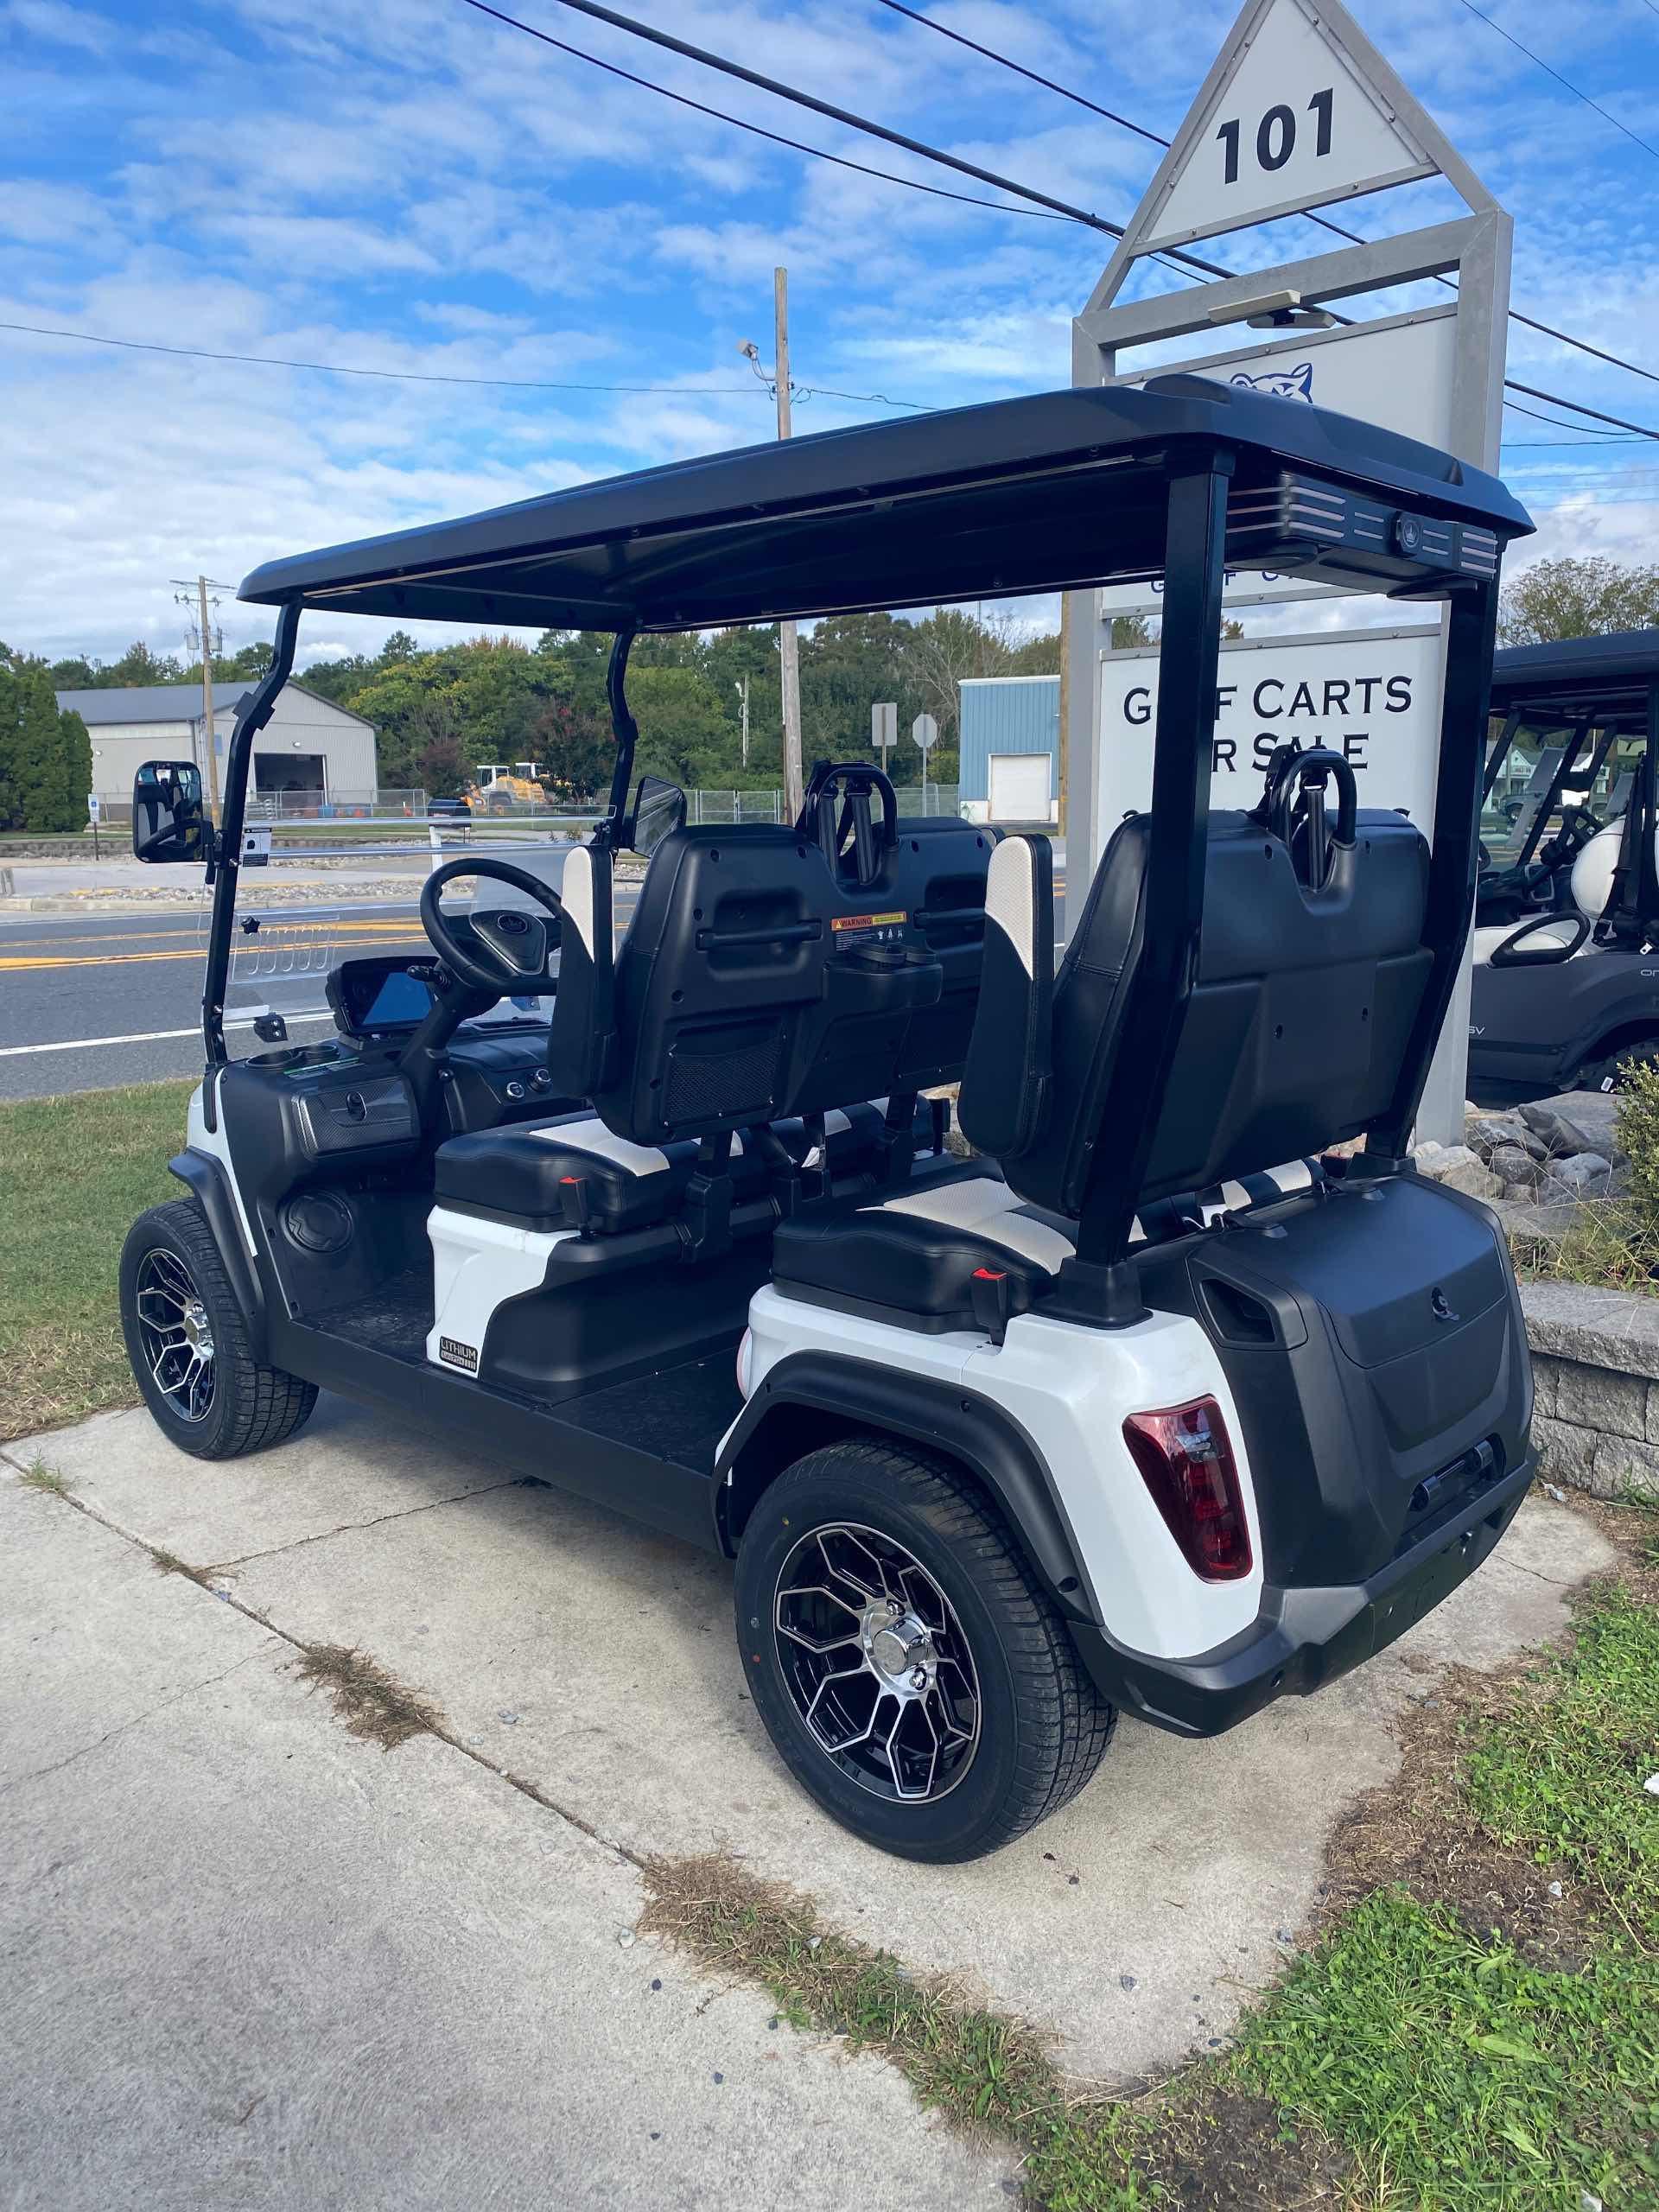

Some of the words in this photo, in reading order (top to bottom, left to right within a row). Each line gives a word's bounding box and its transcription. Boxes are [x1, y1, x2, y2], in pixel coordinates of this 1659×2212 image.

[1216, 88, 1333, 184] 101
[1123, 684, 1237, 724] GF
[1253, 676, 1412, 718] CARTS
[1251, 733, 1369, 771] SE
[842, 918, 872, 927] WARNING
[441, 1338, 476, 1361] LITHIUM
